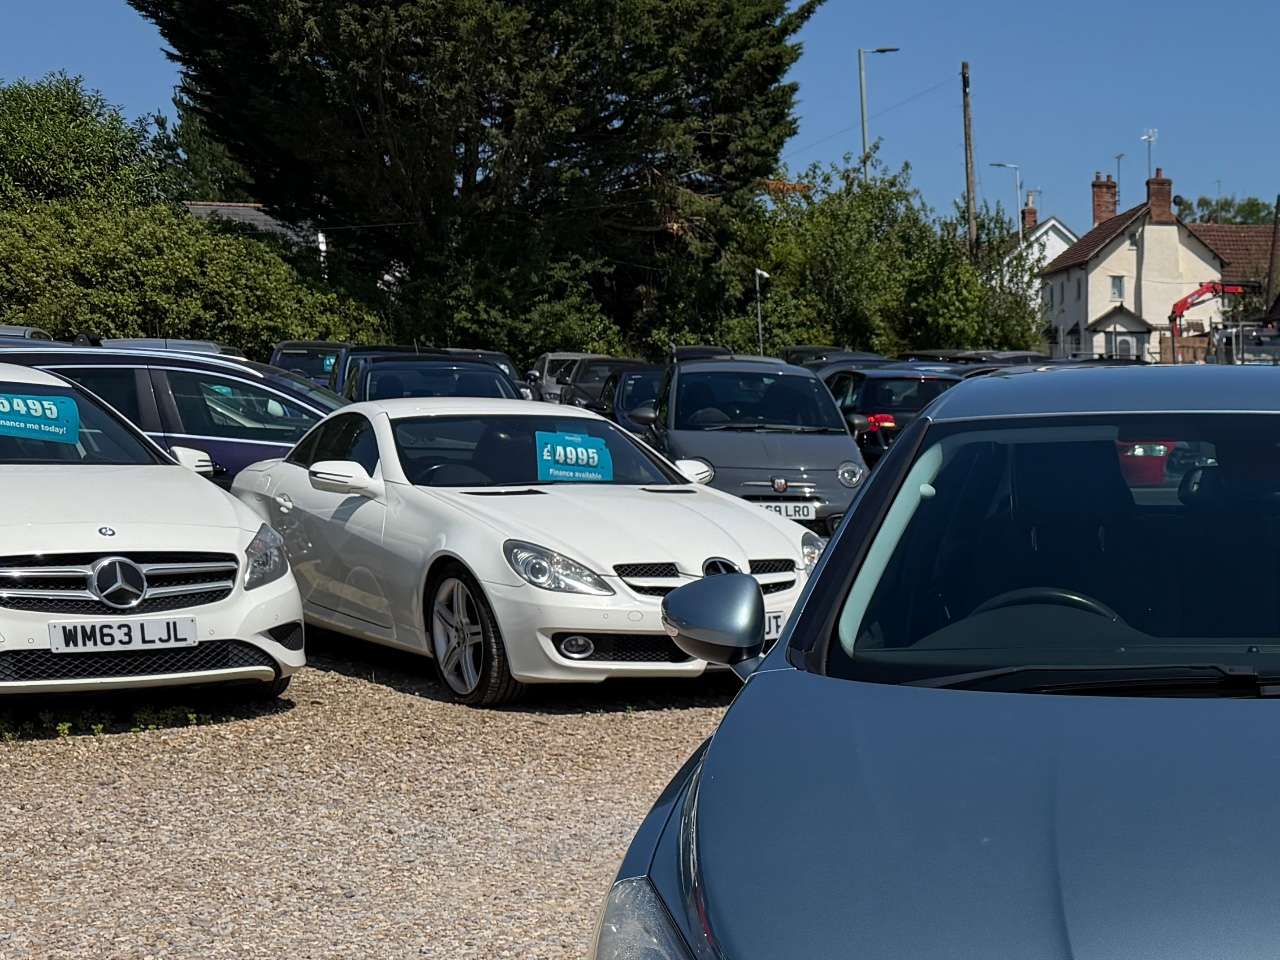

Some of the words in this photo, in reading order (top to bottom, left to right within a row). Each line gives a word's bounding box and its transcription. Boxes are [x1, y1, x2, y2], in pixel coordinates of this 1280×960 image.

[41, 424, 66, 434] today!
[549, 468, 574, 477] Finance
[785, 505, 810, 517] LRO
[62, 623, 133, 648] WM63
[140, 621, 188, 644] LJL
